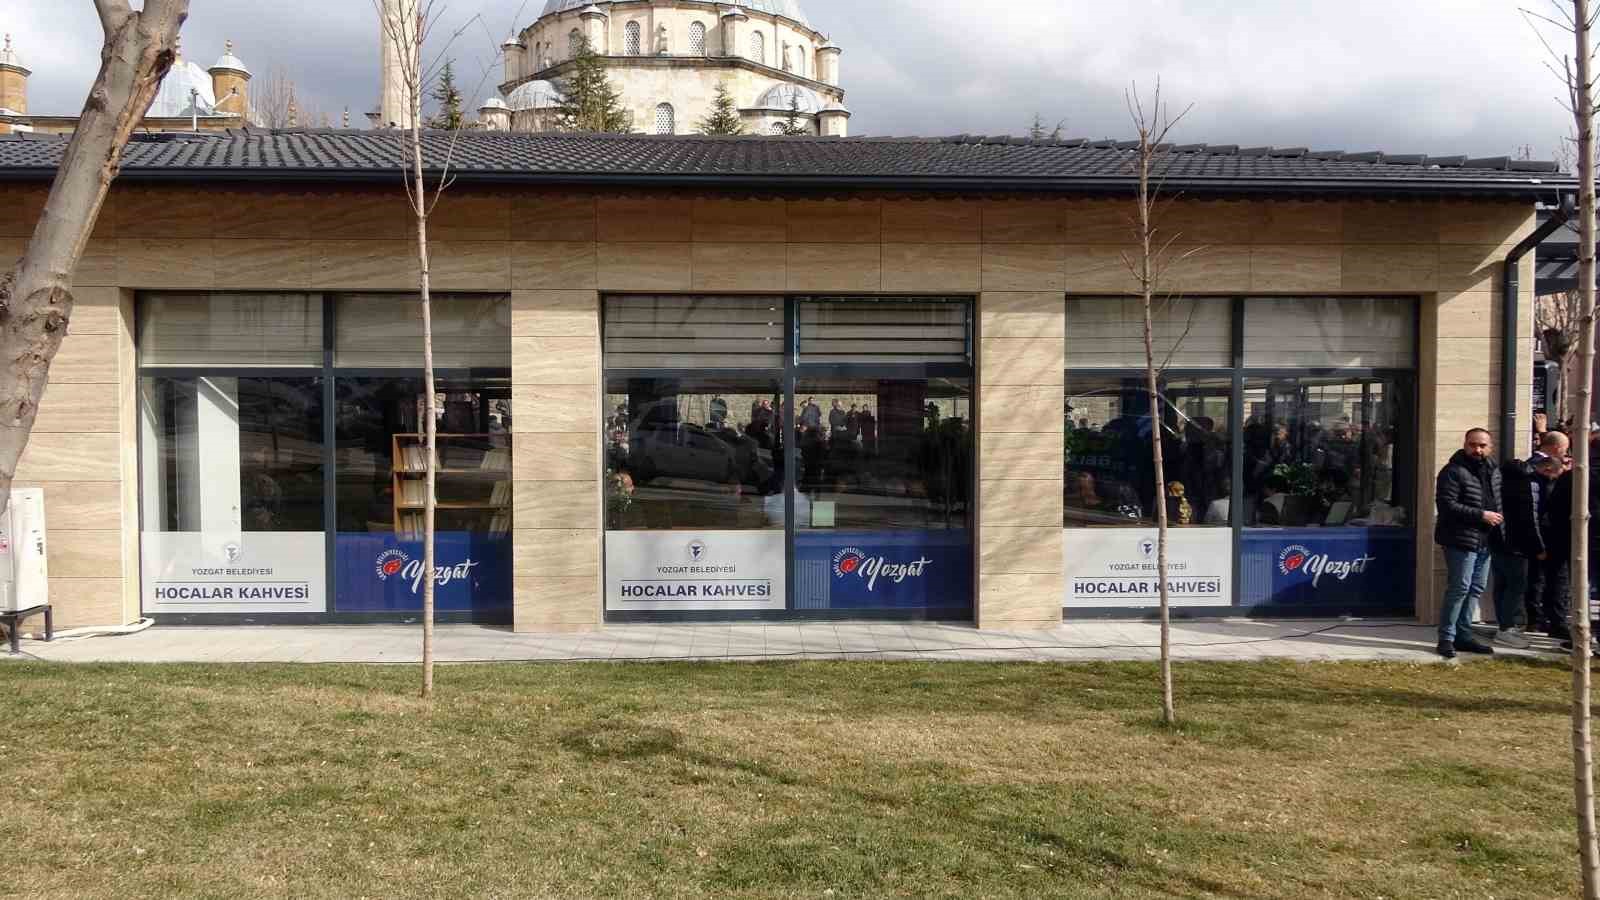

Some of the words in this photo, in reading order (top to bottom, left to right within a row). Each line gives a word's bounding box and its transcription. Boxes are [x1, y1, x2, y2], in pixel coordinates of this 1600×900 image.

[192, 567, 224, 575] YOZGAT
[401, 558, 479, 593] Yzgat
[857, 556, 933, 591] Yozgat
[1302, 553, 1376, 588] Yozgat
[155, 587, 233, 598] HOCALAR
[239, 584, 309, 598] KAHVESİ
[621, 584, 697, 596] HOCALAR
[703, 582, 771, 596] KAHVESİ
[1074, 582, 1148, 593] HOCALAR
